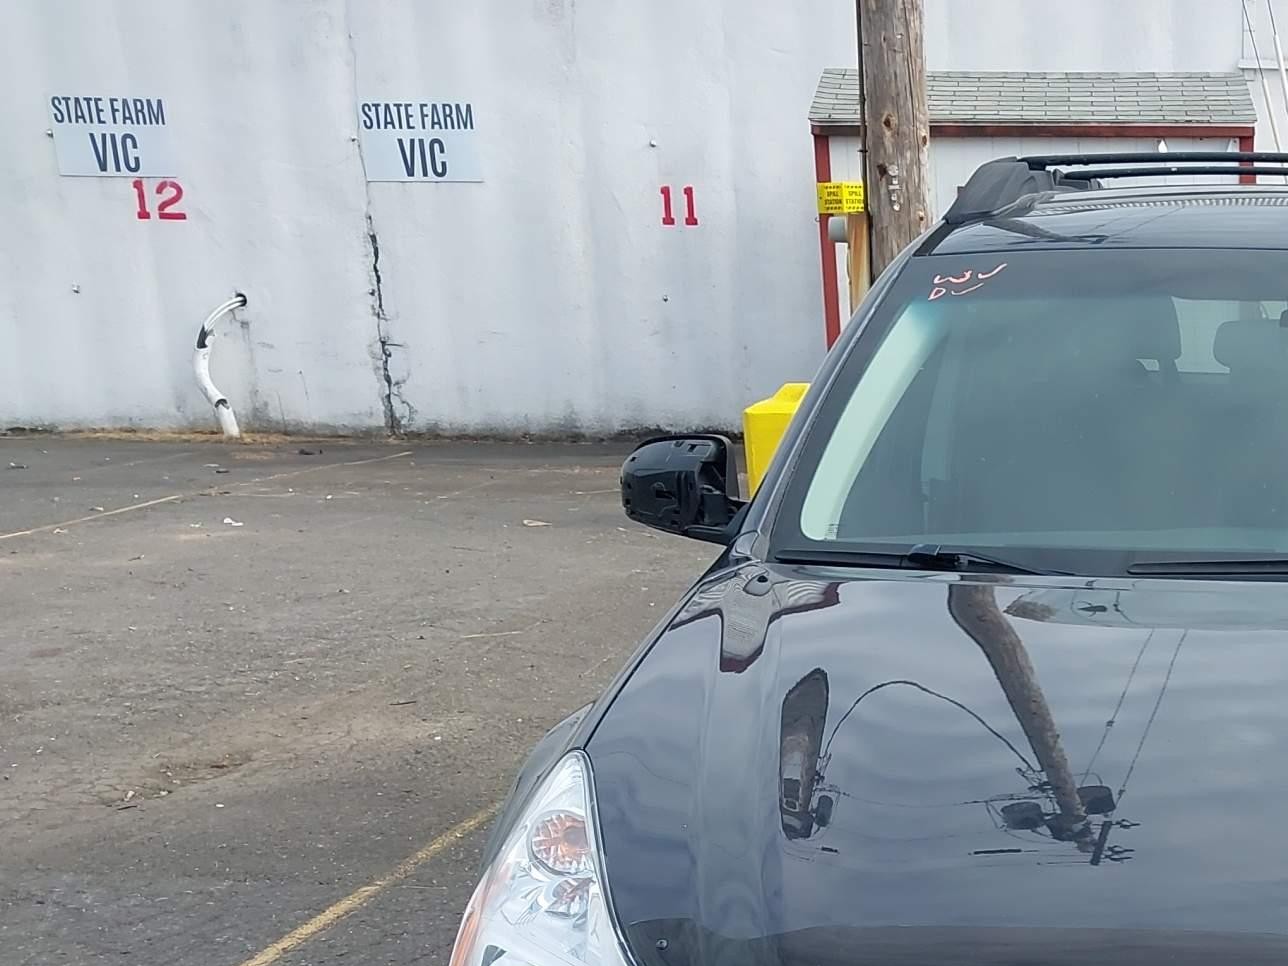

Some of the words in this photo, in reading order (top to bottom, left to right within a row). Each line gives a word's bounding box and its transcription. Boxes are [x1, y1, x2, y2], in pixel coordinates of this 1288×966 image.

[50, 96, 106, 125] STATE
[109, 97, 166, 126] FARM
[361, 102, 416, 130] STATE
[419, 103, 474, 130] FARM
[88, 132, 141, 173] VIC
[396, 137, 448, 178] VIC
[132, 179, 187, 220] 12
[659, 185, 698, 227] 11
